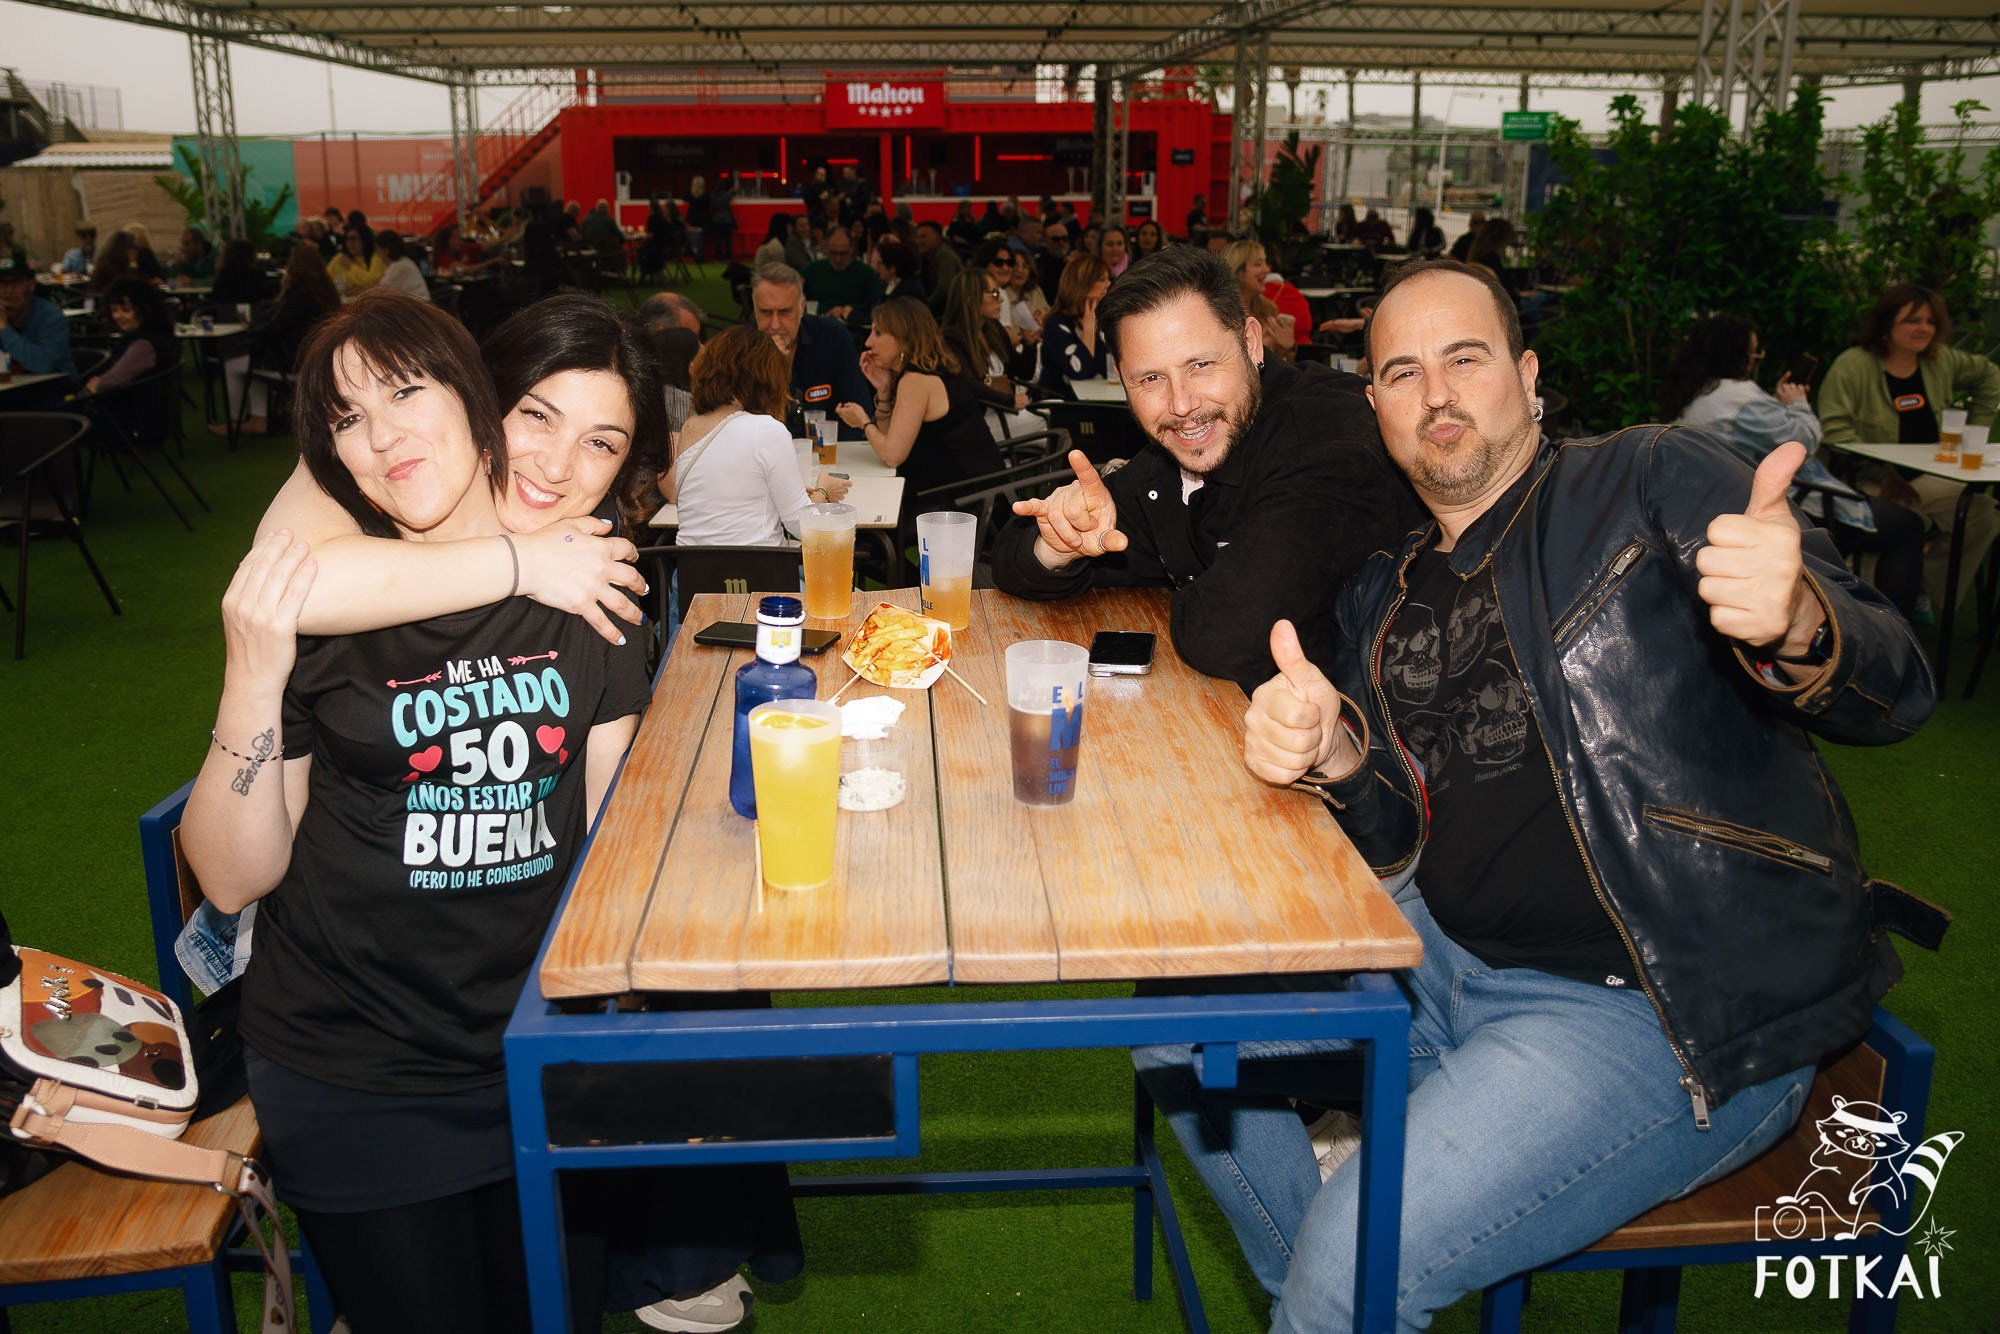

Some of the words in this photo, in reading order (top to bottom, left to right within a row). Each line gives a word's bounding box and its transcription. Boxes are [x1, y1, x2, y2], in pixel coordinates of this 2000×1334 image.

[846, 82, 926, 105] Mahou
[446, 659, 476, 684] ME
[478, 655, 506, 679] HA
[391, 666, 570, 748] COSTADO
[449, 720, 530, 786] 50
[406, 781, 463, 812] AÑOS
[468, 781, 533, 811] ESTAR
[403, 800, 557, 868] BUENA
[409, 870, 448, 890] (PERO
[450, 870, 464, 889] LO
[467, 869, 483, 888] HE
[486, 852, 554, 886] CONSEGUIDO)
